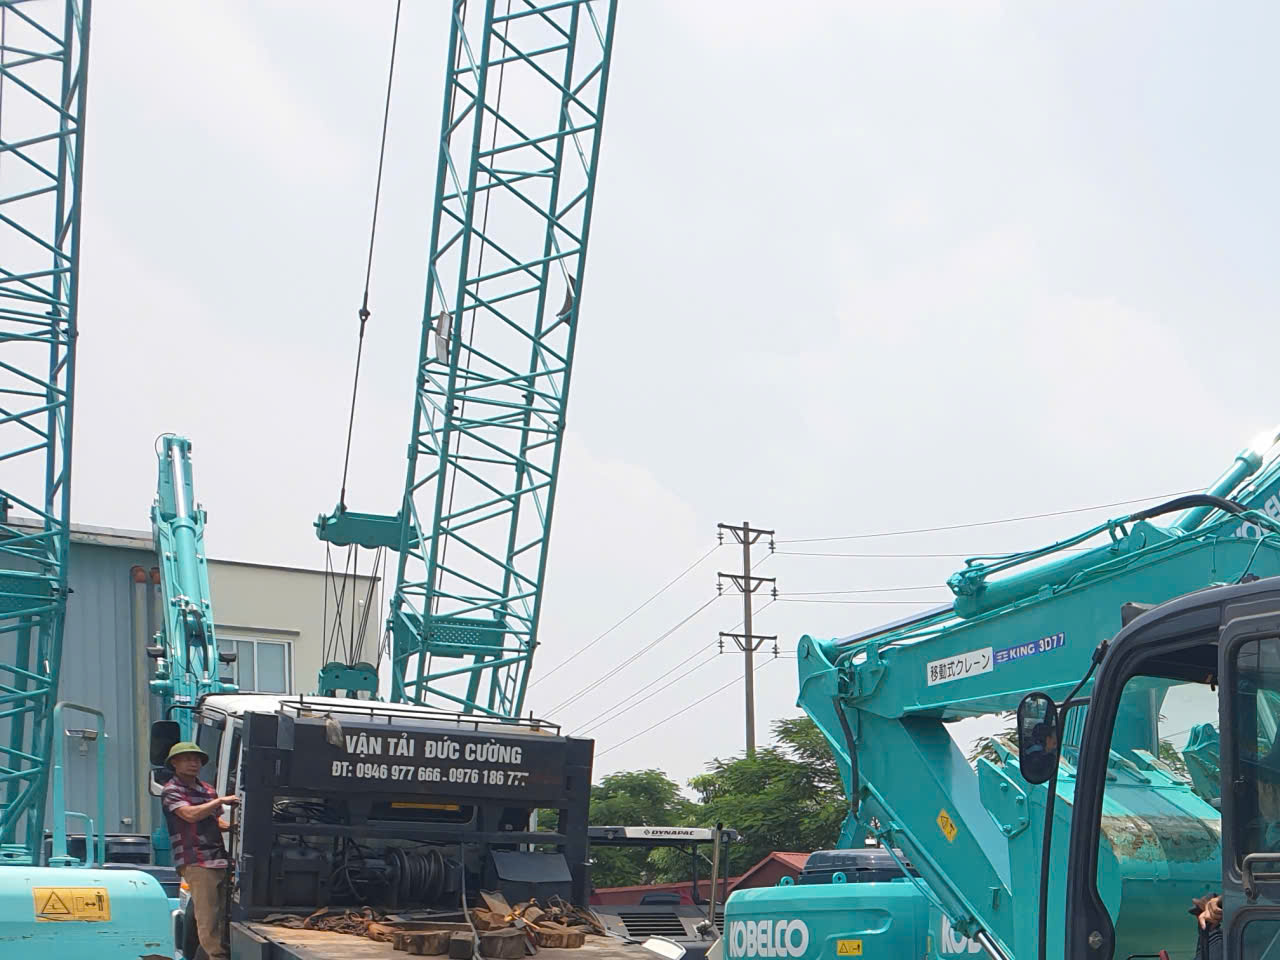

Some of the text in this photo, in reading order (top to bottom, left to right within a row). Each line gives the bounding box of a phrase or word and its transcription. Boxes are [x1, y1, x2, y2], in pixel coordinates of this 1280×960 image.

[1009, 632, 1065, 660] KING 3D77
[930, 653, 990, 682] 移動式クレーン
[345, 732, 522, 764] VẬN TẢI ĐỨC CƯỜNG
[331, 760, 353, 777] ĐT:
[356, 762, 388, 779] 0946
[391, 765, 415, 781] 977
[482, 770, 504, 785] 186
[729, 919, 809, 957] KOBELCO
